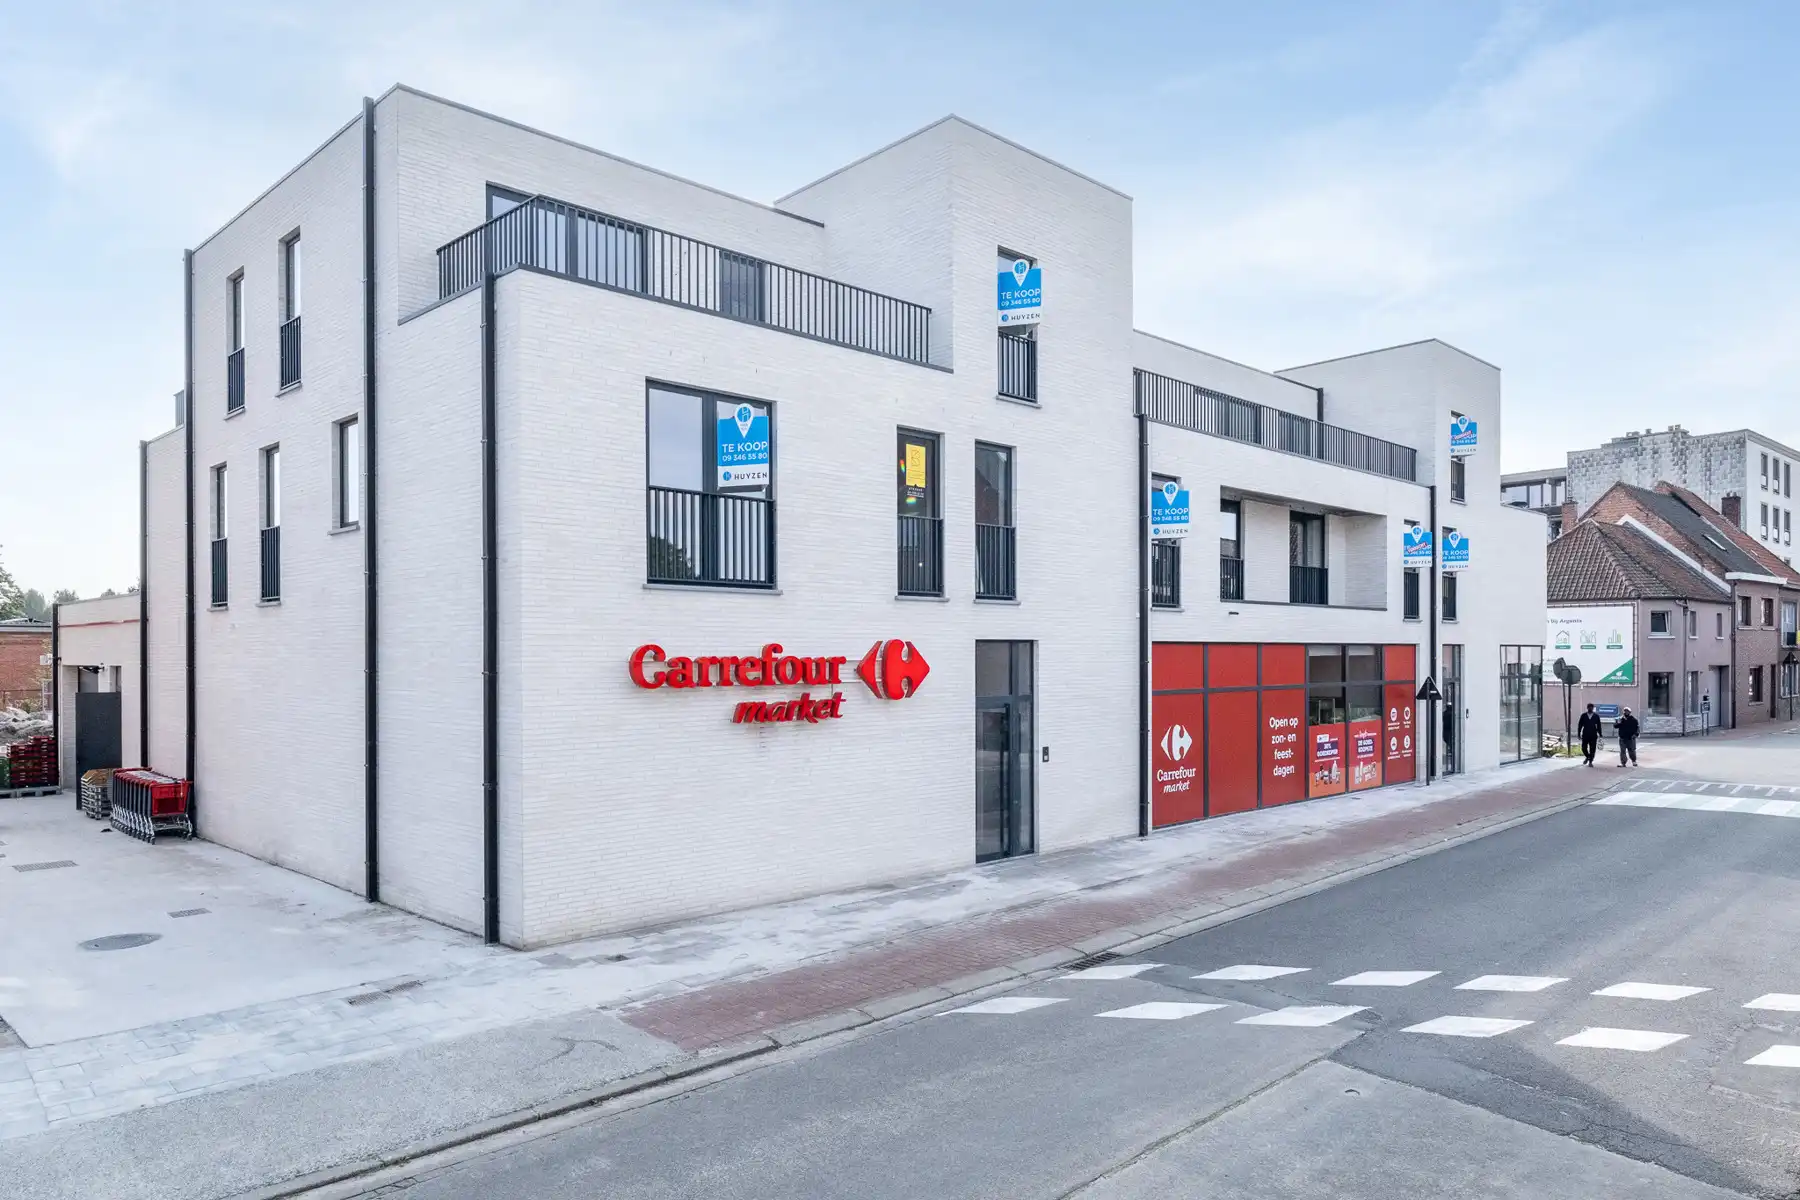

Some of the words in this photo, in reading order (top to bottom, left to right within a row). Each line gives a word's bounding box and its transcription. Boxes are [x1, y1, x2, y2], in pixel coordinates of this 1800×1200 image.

[1014, 288, 1040, 298] KOOP
[722, 443, 735, 453] TE
[737, 441, 768, 452] KOOP
[722, 454, 732, 462] 09
[734, 471, 767, 480] HUYZEN
[1164, 507, 1188, 515] KOOP
[628, 643, 847, 689] Carrefour
[732, 691, 846, 724] market
[1269, 716, 1289, 729] Open
[1289, 716, 1299, 728] op
[1271, 735, 1287, 745] zon-
[1287, 733, 1296, 742] en
[1274, 748, 1294, 760] feest-
[1157, 765, 1196, 782] Carrefour
[1273, 764, 1295, 778] dagen
[1163, 779, 1191, 794] market
